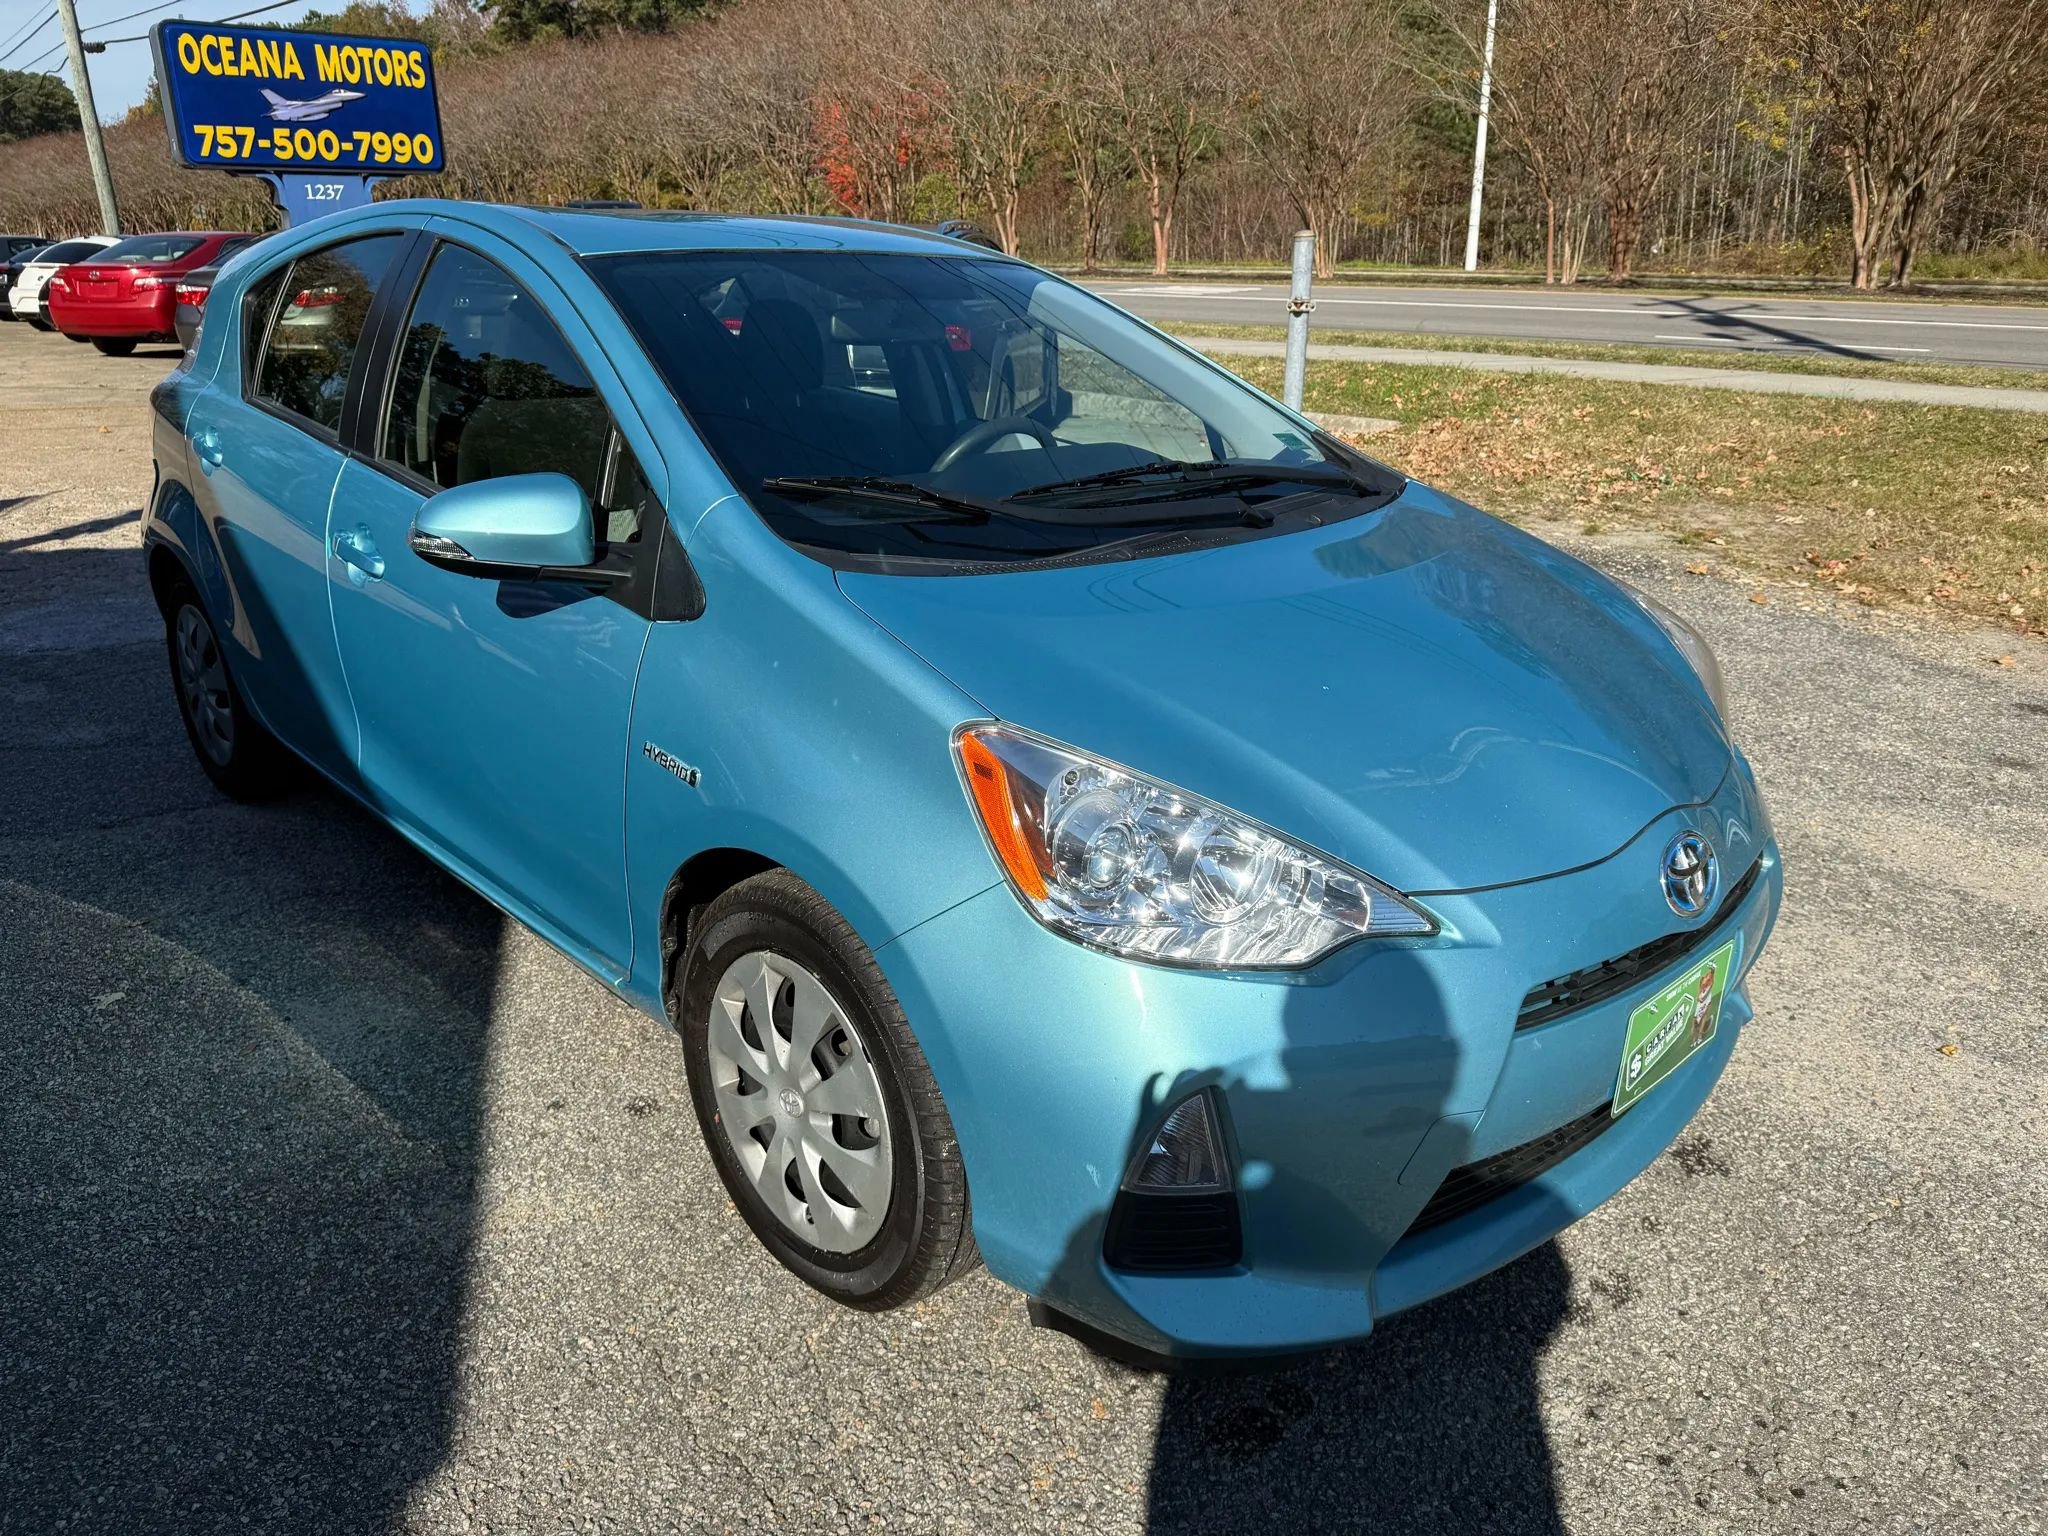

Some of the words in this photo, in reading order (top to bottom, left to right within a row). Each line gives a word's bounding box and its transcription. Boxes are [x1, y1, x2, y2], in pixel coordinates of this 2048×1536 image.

[178, 32, 305, 81] OCEANA
[314, 44, 427, 89] MOTORS
[193, 124, 434, 165] 757-500-7990
[304, 183, 344, 201] 1237
[643, 741, 690, 784] HYBRID
